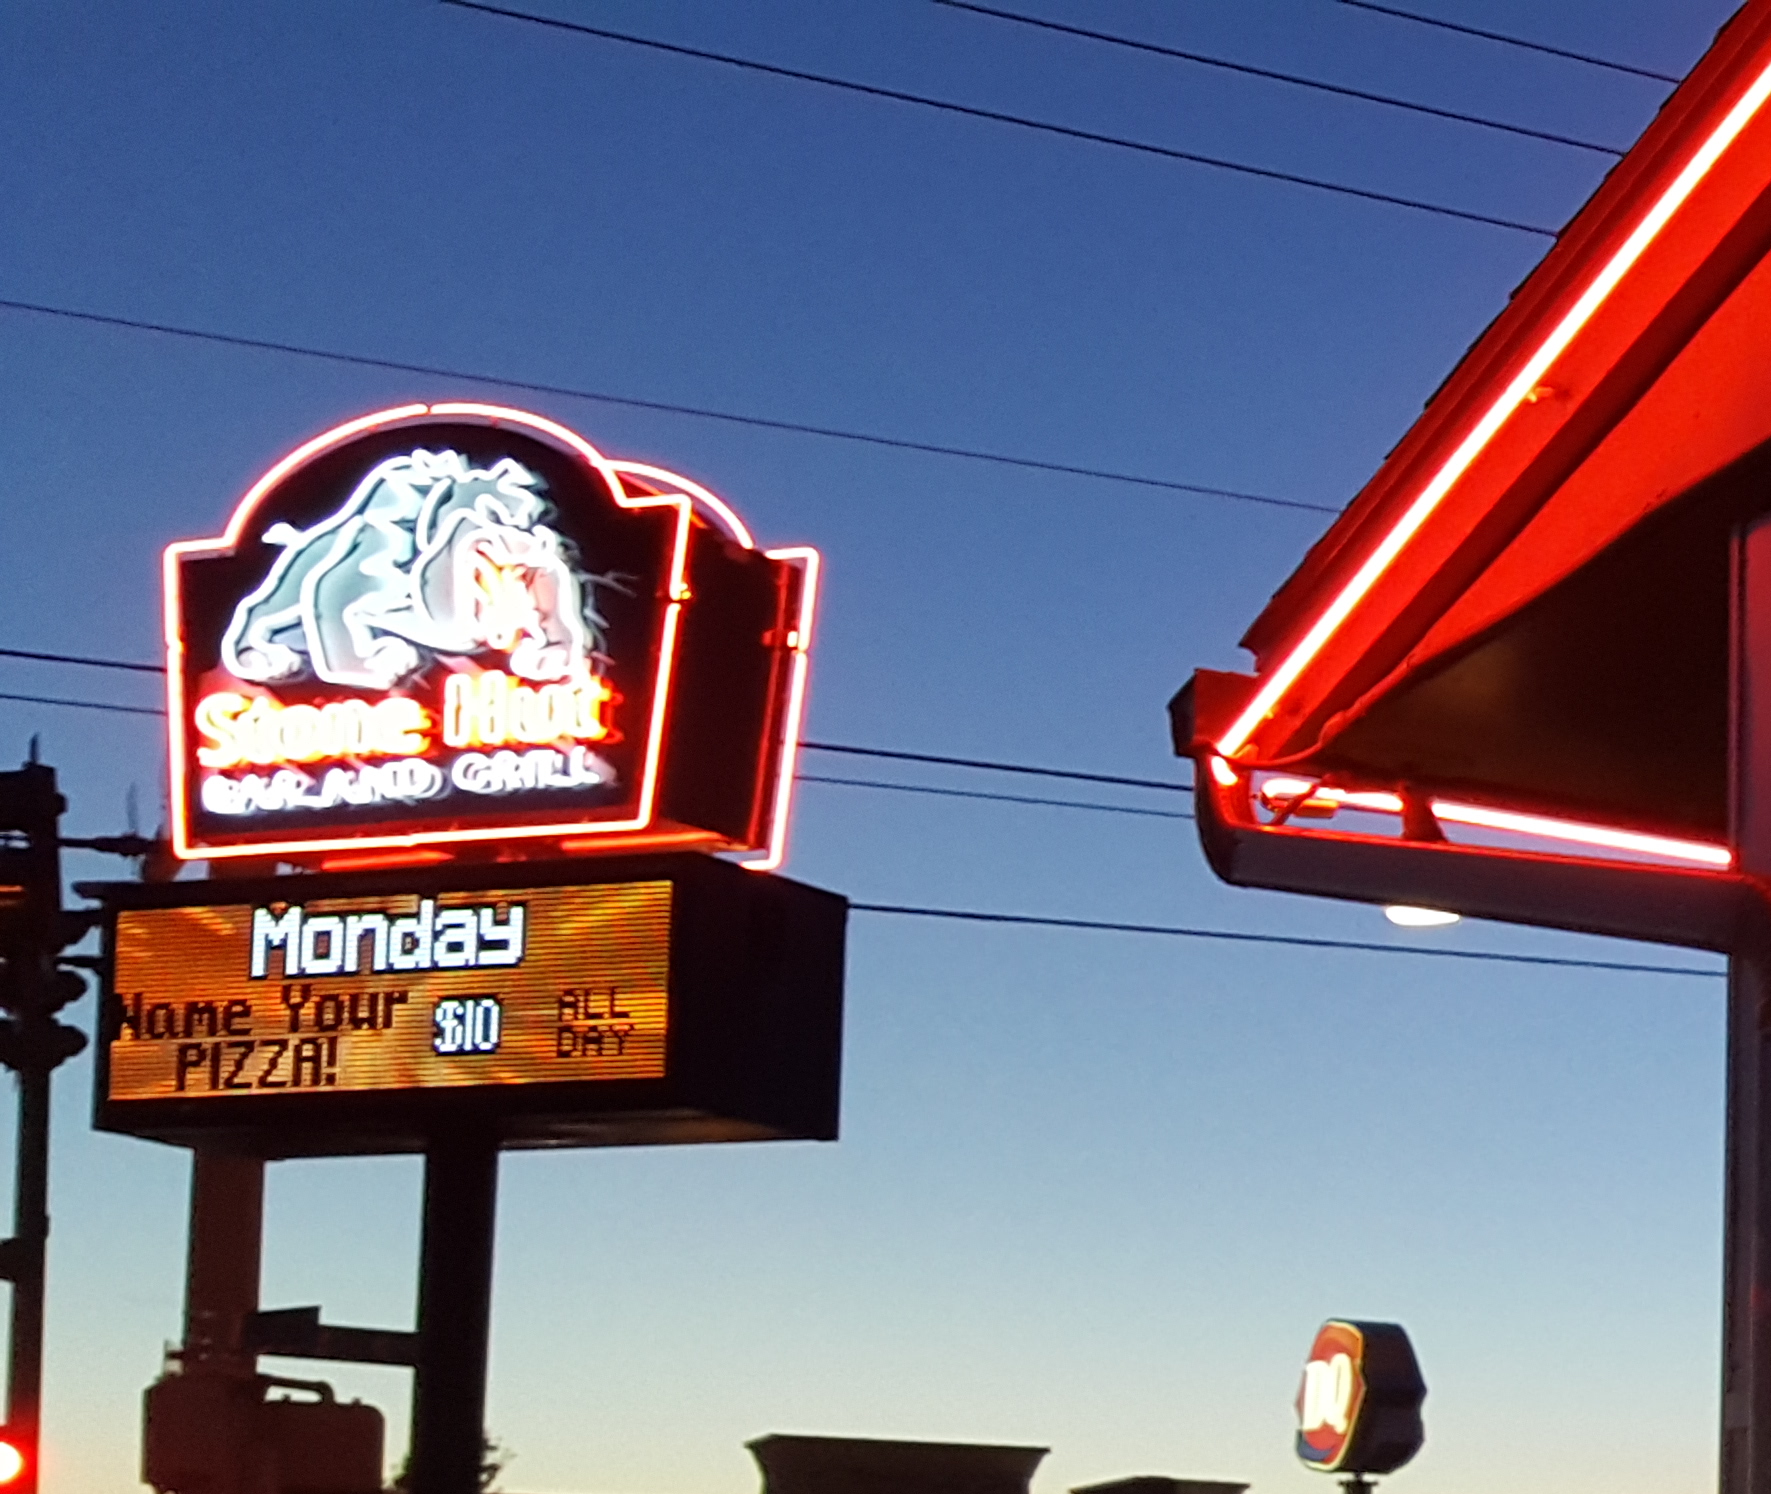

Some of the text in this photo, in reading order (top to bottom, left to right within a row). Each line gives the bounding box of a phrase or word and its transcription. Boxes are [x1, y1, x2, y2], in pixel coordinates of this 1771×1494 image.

[250, 899, 526, 979] Monday
[114, 984, 630, 1054] Name Your $10 ALL
[175, 1022, 632, 1091] PIZZA! DAY
[1302, 1352, 1351, 1434] DQ
